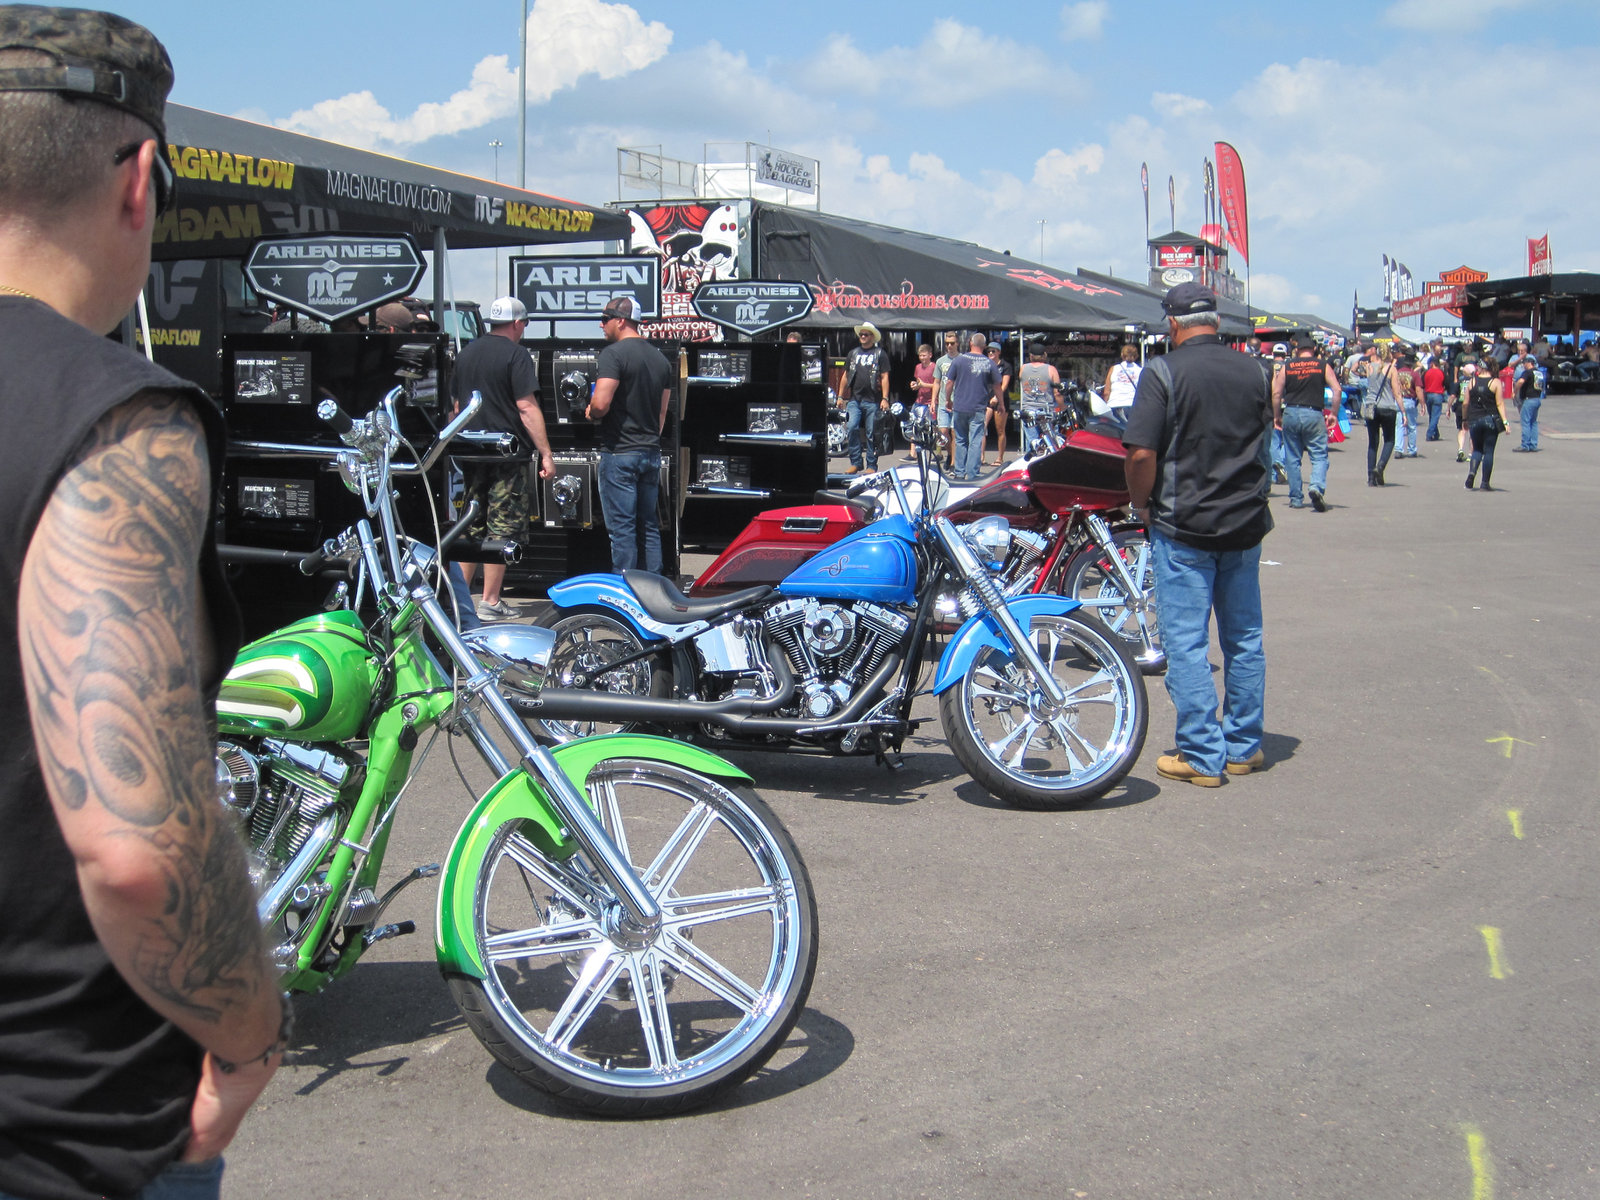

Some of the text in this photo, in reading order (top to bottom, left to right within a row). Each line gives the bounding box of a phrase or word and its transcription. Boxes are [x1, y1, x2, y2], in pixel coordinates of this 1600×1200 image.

[168, 144, 294, 190] AGNAFLOW
[775, 162, 803, 177] HOUSE
[771, 171, 813, 188] BAGGERS
[327, 169, 452, 215] MAGNAFLOW.COM
[505, 200, 595, 232] MAGNAFLOW
[264, 244, 402, 259] ARLEN NESS
[523, 265, 649, 286] ARLEN
[1446, 270, 1481, 283] MOTOR
[706, 287, 800, 296] ARLEN NESS
[308, 297, 358, 305] MAGNAFLOW
[640, 321, 717, 331] COVINGTONS
[1429, 327, 1453, 336] OPEN
[135, 327, 201, 346] ANAFLOW
[651, 330, 706, 339] CUSTOMS
